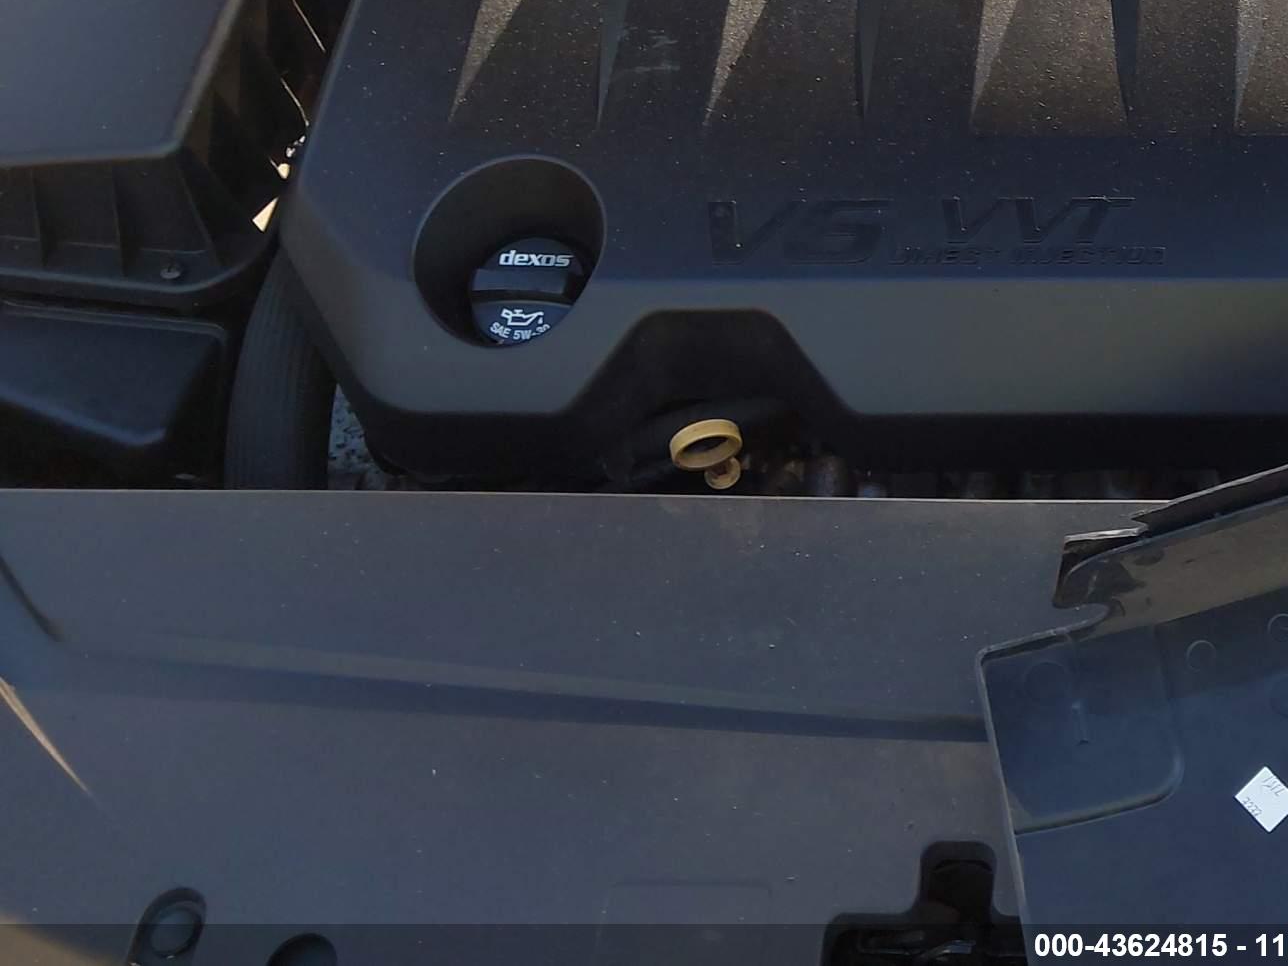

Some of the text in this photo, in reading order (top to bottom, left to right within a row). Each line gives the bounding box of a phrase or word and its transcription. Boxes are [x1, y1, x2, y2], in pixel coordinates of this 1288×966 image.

[707, 196, 1136, 266] V6 VVT
[499, 249, 575, 267] dexos
[489, 321, 512, 339] SAE
